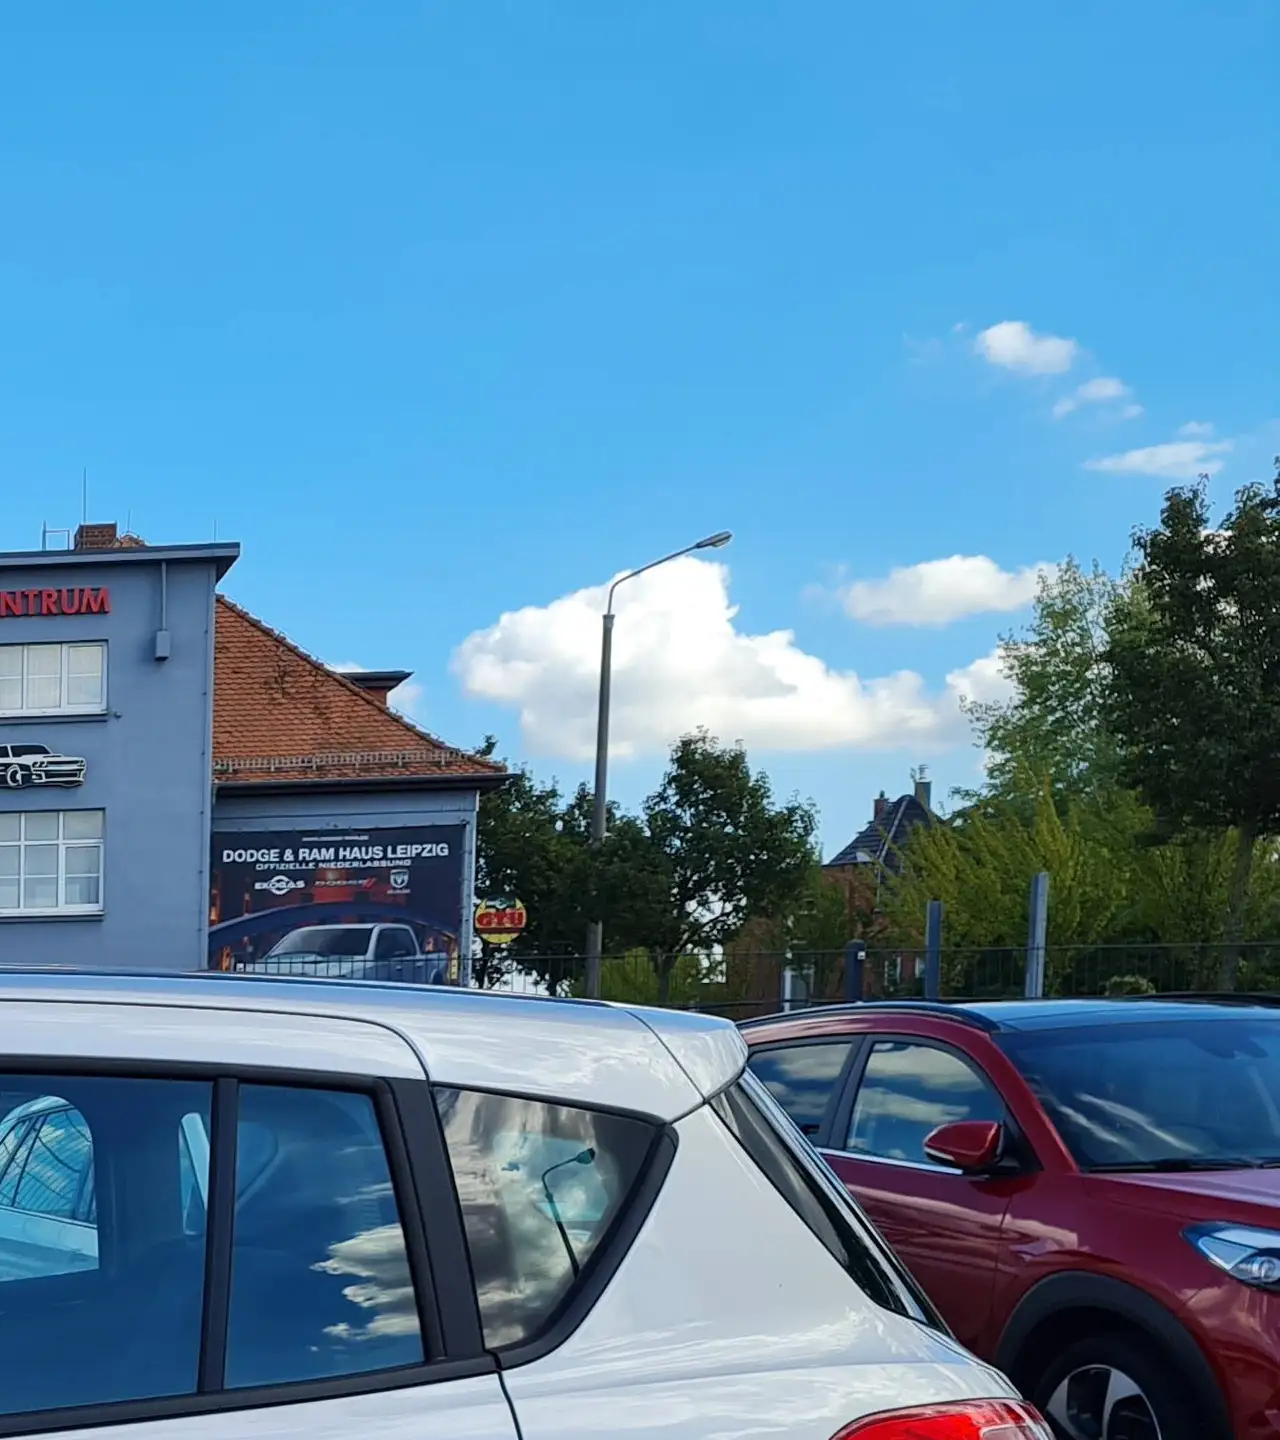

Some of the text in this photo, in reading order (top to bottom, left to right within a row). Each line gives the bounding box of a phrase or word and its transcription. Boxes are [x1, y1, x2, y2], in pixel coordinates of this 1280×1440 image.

[222, 842, 449, 863] DODGE & RAM HAUS LEIPZIG
[255, 859, 412, 871] OFFIZIELLE NIEDERLASSUNG
